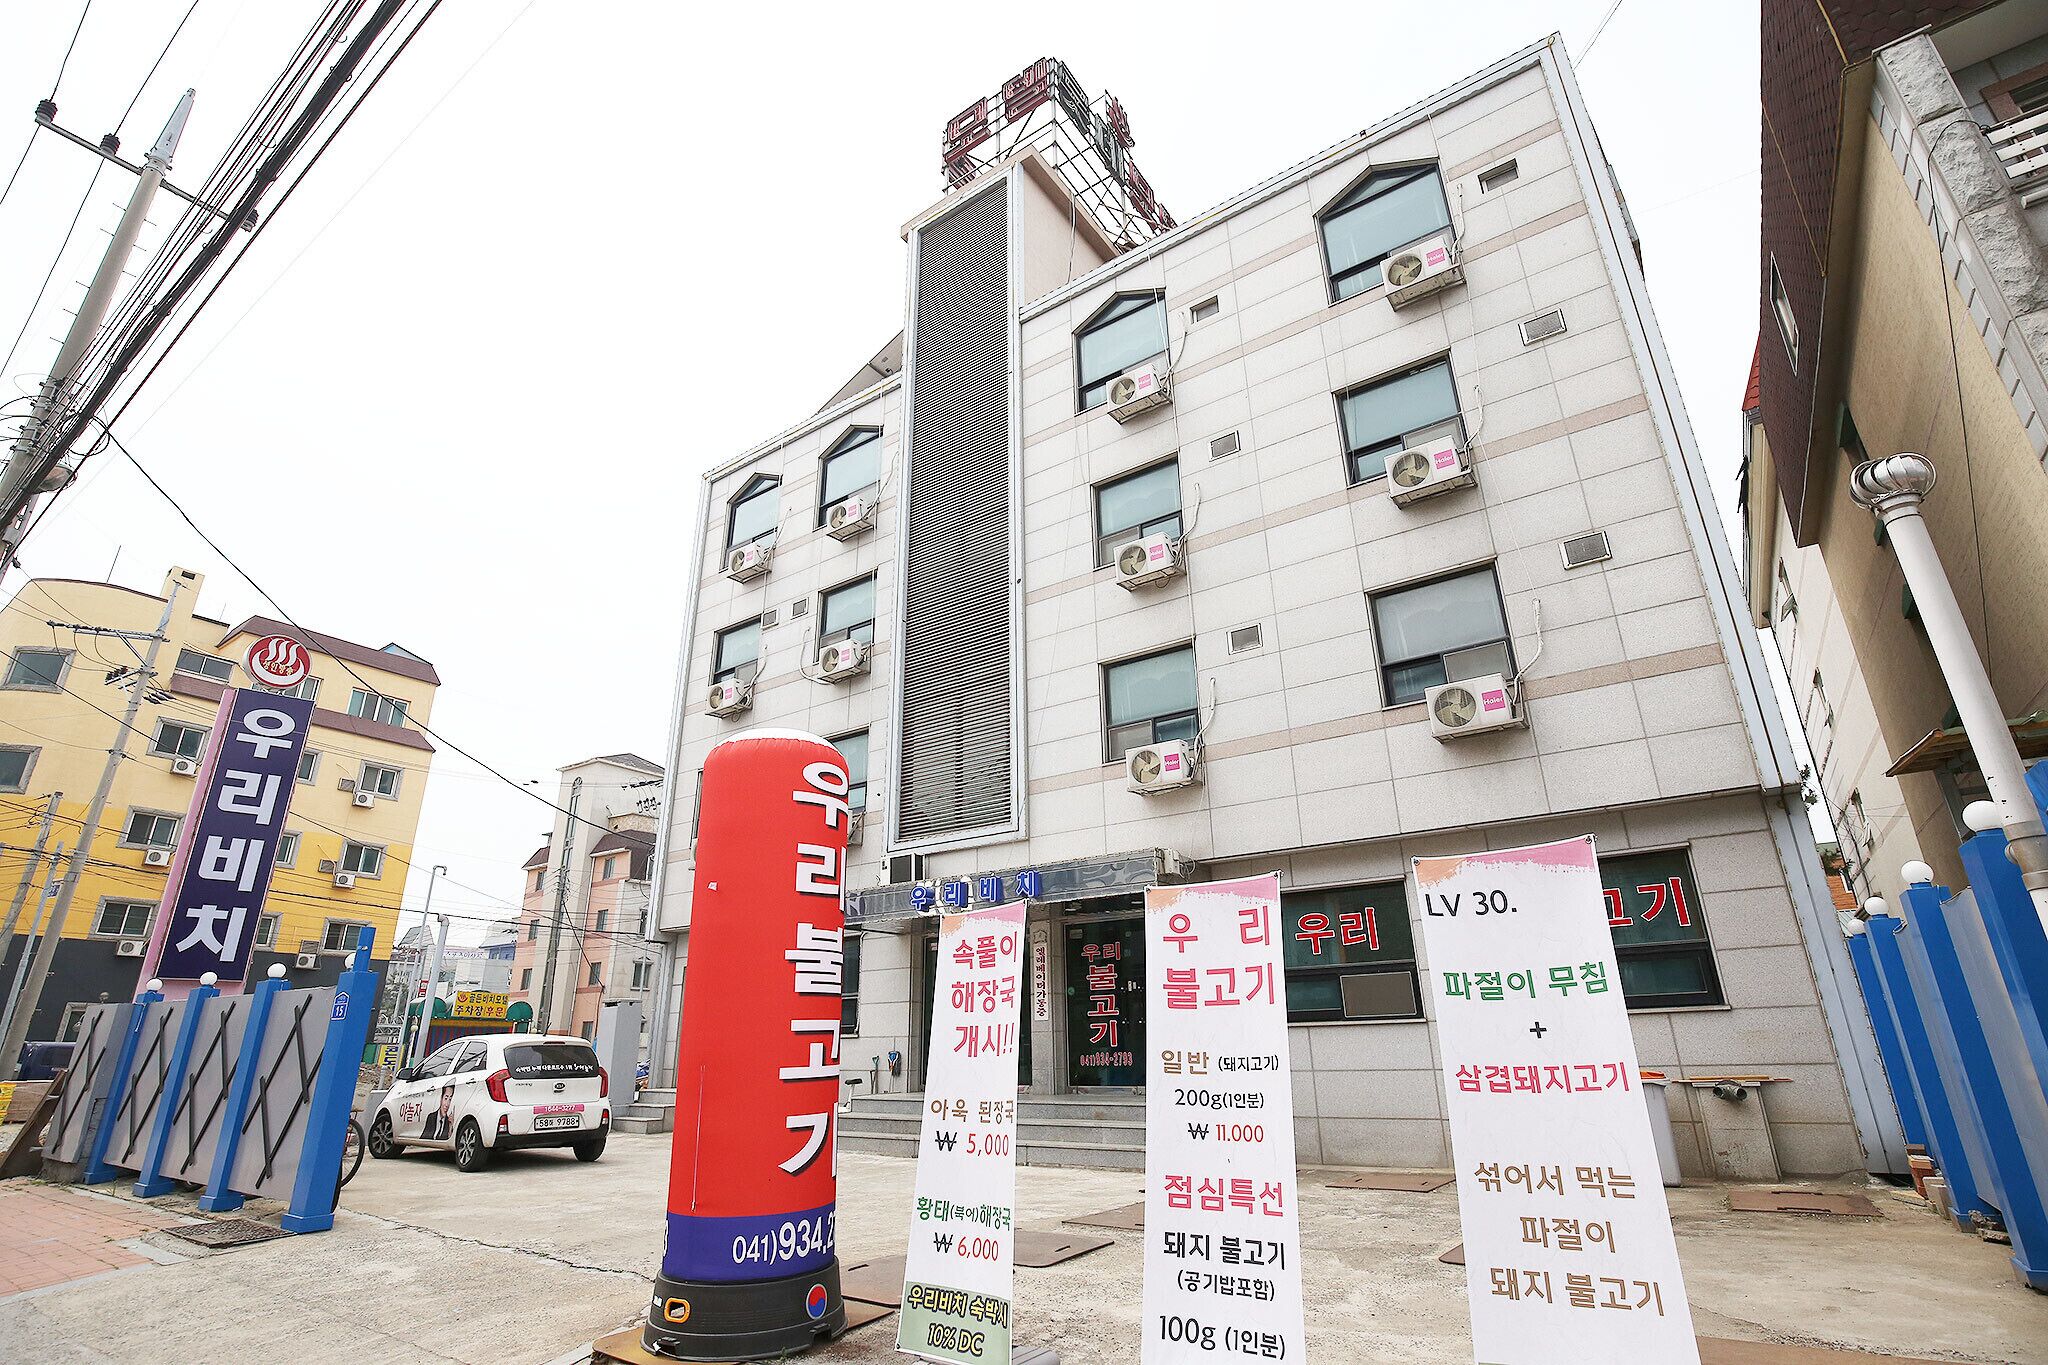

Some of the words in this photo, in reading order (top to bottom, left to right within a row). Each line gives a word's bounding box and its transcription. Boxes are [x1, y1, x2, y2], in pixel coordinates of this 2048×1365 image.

[1483, 696, 1504, 705] Haier
[175, 708, 295, 963] 우리비치
[910, 870, 1040, 911] 우리비치
[1425, 893, 1461, 918] LV
[1472, 889, 1518, 917] 30.
[1294, 906, 1380, 955] 우리
[952, 931, 1018, 970] 속풀이
[1081, 942, 1121, 963] 우리
[951, 975, 1016, 1014] 해장국
[1163, 962, 1275, 1010] 불고기
[1443, 968, 1537, 1001] 파절이
[1548, 961, 1610, 997] 무침
[335, 1005, 345, 1017] 15
[455, 1005, 484, 1017] 주차장
[1086, 963, 1120, 1048] 불고기
[953, 1022, 1015, 1058] 개시!!
[1161, 1050, 1210, 1075] 일반
[1218, 1055, 1279, 1073] (돼지고기)
[1455, 1060, 1631, 1094] 삼겹돼지고기
[930, 1098, 969, 1123] 아욱
[978, 1099, 1014, 1125] 된장국
[1174, 1088, 1264, 1110] 200g(1인분)
[556, 1117, 577, 1127] 9788
[1215, 1123, 1264, 1143] 11.000
[966, 1133, 1010, 1157] 5,000
[1164, 1174, 1284, 1217] 점심특선
[1474, 1162, 1565, 1196] 섞어서
[1575, 1166, 1636, 1200] 먹는
[916, 1196, 1012, 1232] 황태(북어)해장국
[957, 1235, 1000, 1262] 6,000
[1163, 1231, 1210, 1261] 돼지
[1219, 1235, 1286, 1270] 불고기
[1519, 1216, 1616, 1254] 파절이
[1177, 1269, 1275, 1302] (공기밥포함)
[1490, 1267, 1553, 1304] 돼지
[1564, 1272, 1665, 1317] 불고기
[907, 1283, 969, 1318] 우리비치
[969, 1295, 1009, 1329] 숙박시
[927, 1322, 955, 1350] 10%
[958, 1330, 985, 1357] DC
[1159, 1315, 1217, 1351] 100g
[1224, 1325, 1286, 1361] (1인분)
